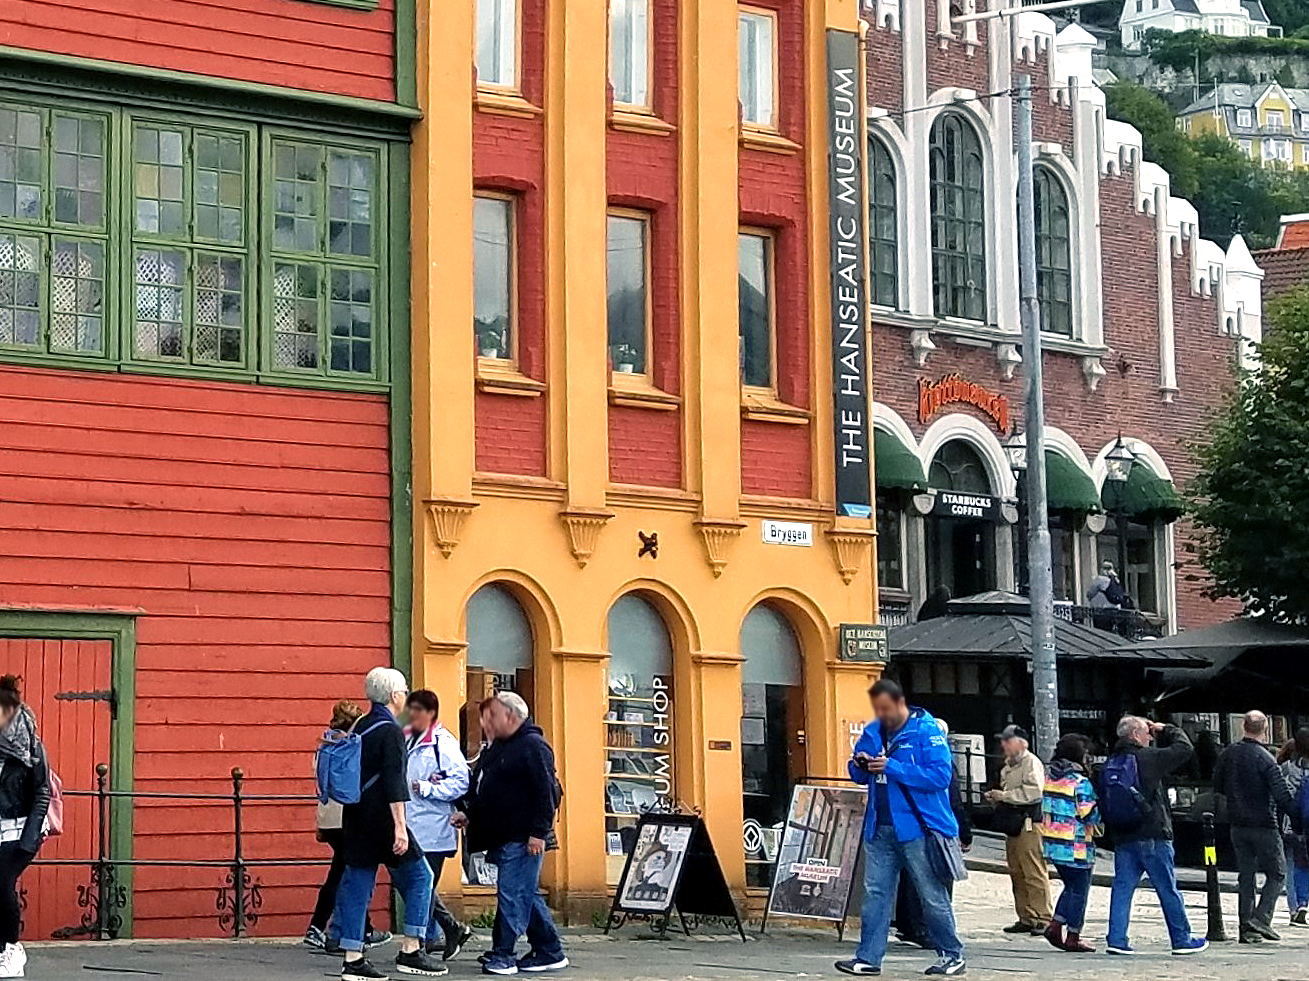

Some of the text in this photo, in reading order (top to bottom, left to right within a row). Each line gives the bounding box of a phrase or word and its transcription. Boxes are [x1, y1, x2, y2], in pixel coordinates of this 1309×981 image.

[834, 68, 862, 467] THE HANSEATIC MUSEUM
[942, 493, 991, 508] STARBUCKS
[952, 504, 983, 517] COFFEE
[771, 524, 807, 542] Bryggen
[652, 677, 669, 746] SHOP
